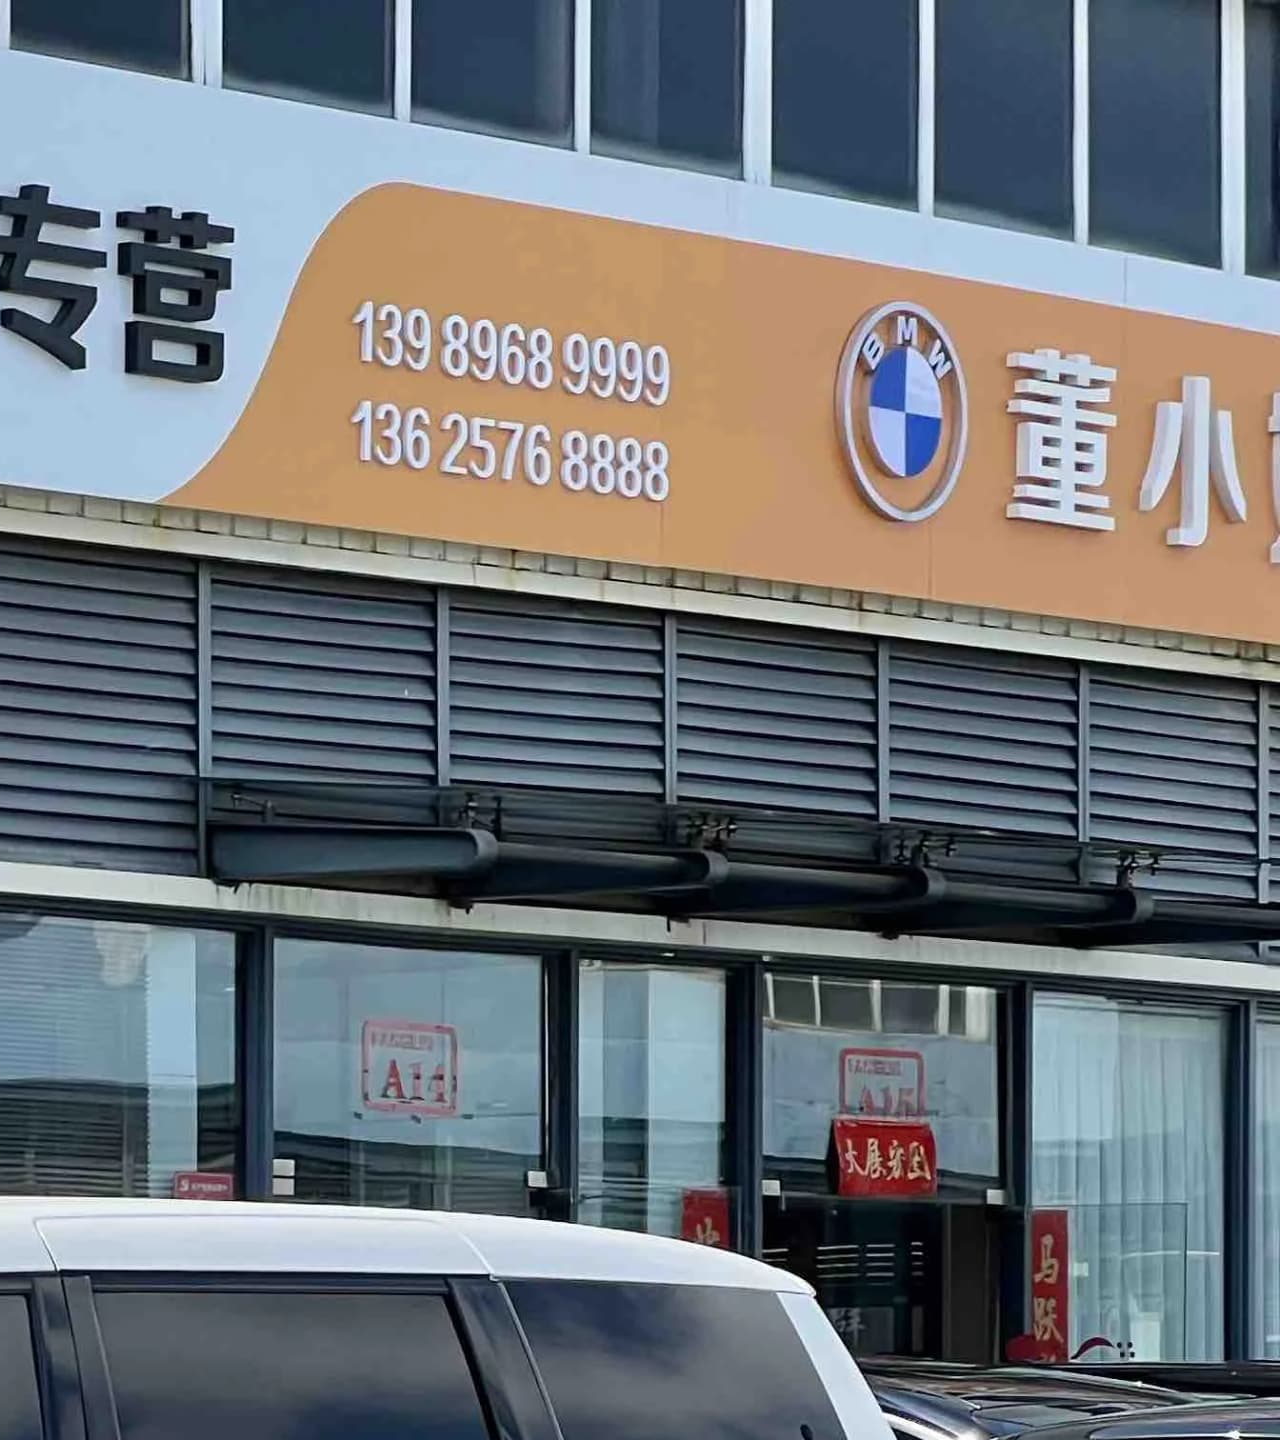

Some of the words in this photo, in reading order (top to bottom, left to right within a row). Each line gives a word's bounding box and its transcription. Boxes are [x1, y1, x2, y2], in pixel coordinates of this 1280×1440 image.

[351, 300, 433, 372] 139
[441, 314, 554, 390] 8968
[561, 333, 672, 407] 9999
[859, 315, 954, 381] BMW
[350, 399, 432, 470] 136
[439, 412, 553, 486] 2576
[560, 429, 671, 502] 8888
[1006, 347, 1280, 565] 董小
